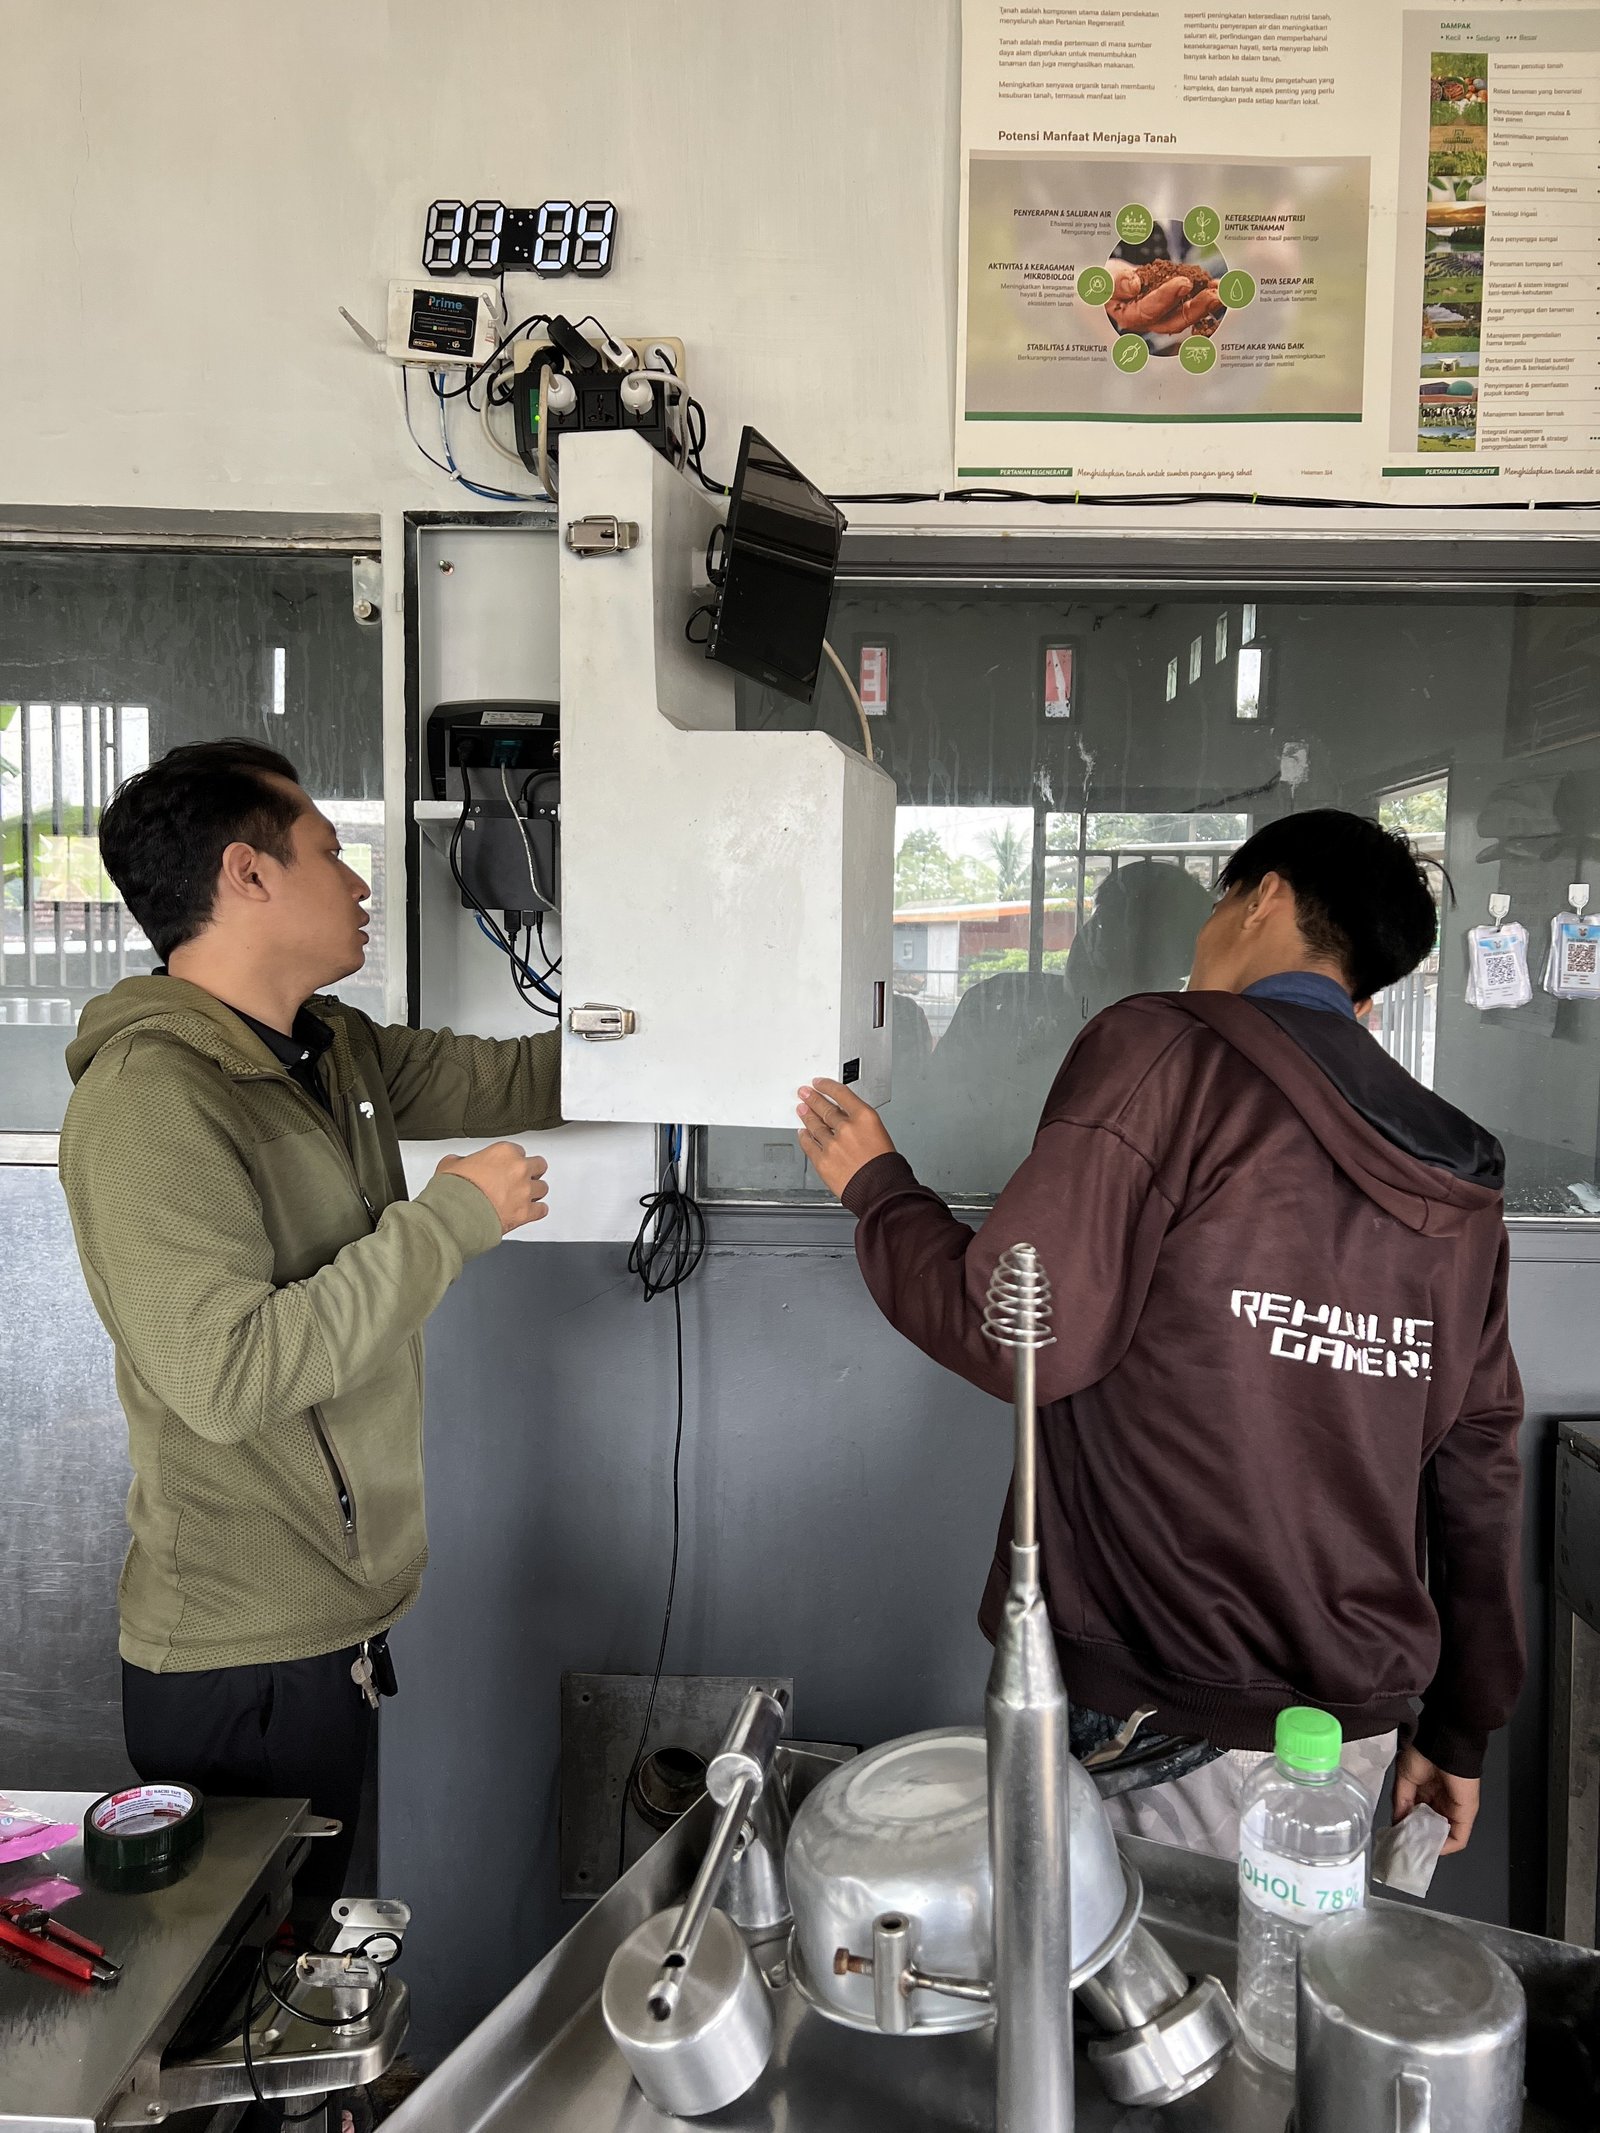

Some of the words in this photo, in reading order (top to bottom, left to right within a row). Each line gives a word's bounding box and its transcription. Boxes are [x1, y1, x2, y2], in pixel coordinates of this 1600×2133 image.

[998, 131, 1039, 141] Potensi
[1043, 131, 1089, 142] Manfaat
[1093, 132, 1140, 145] Menjaga
[1144, 133, 1177, 143] Tanah
[428, 296, 464, 310] Prime
[1240, 1855, 1307, 1908] OHOL
[1316, 1887, 1360, 1910] 78%
